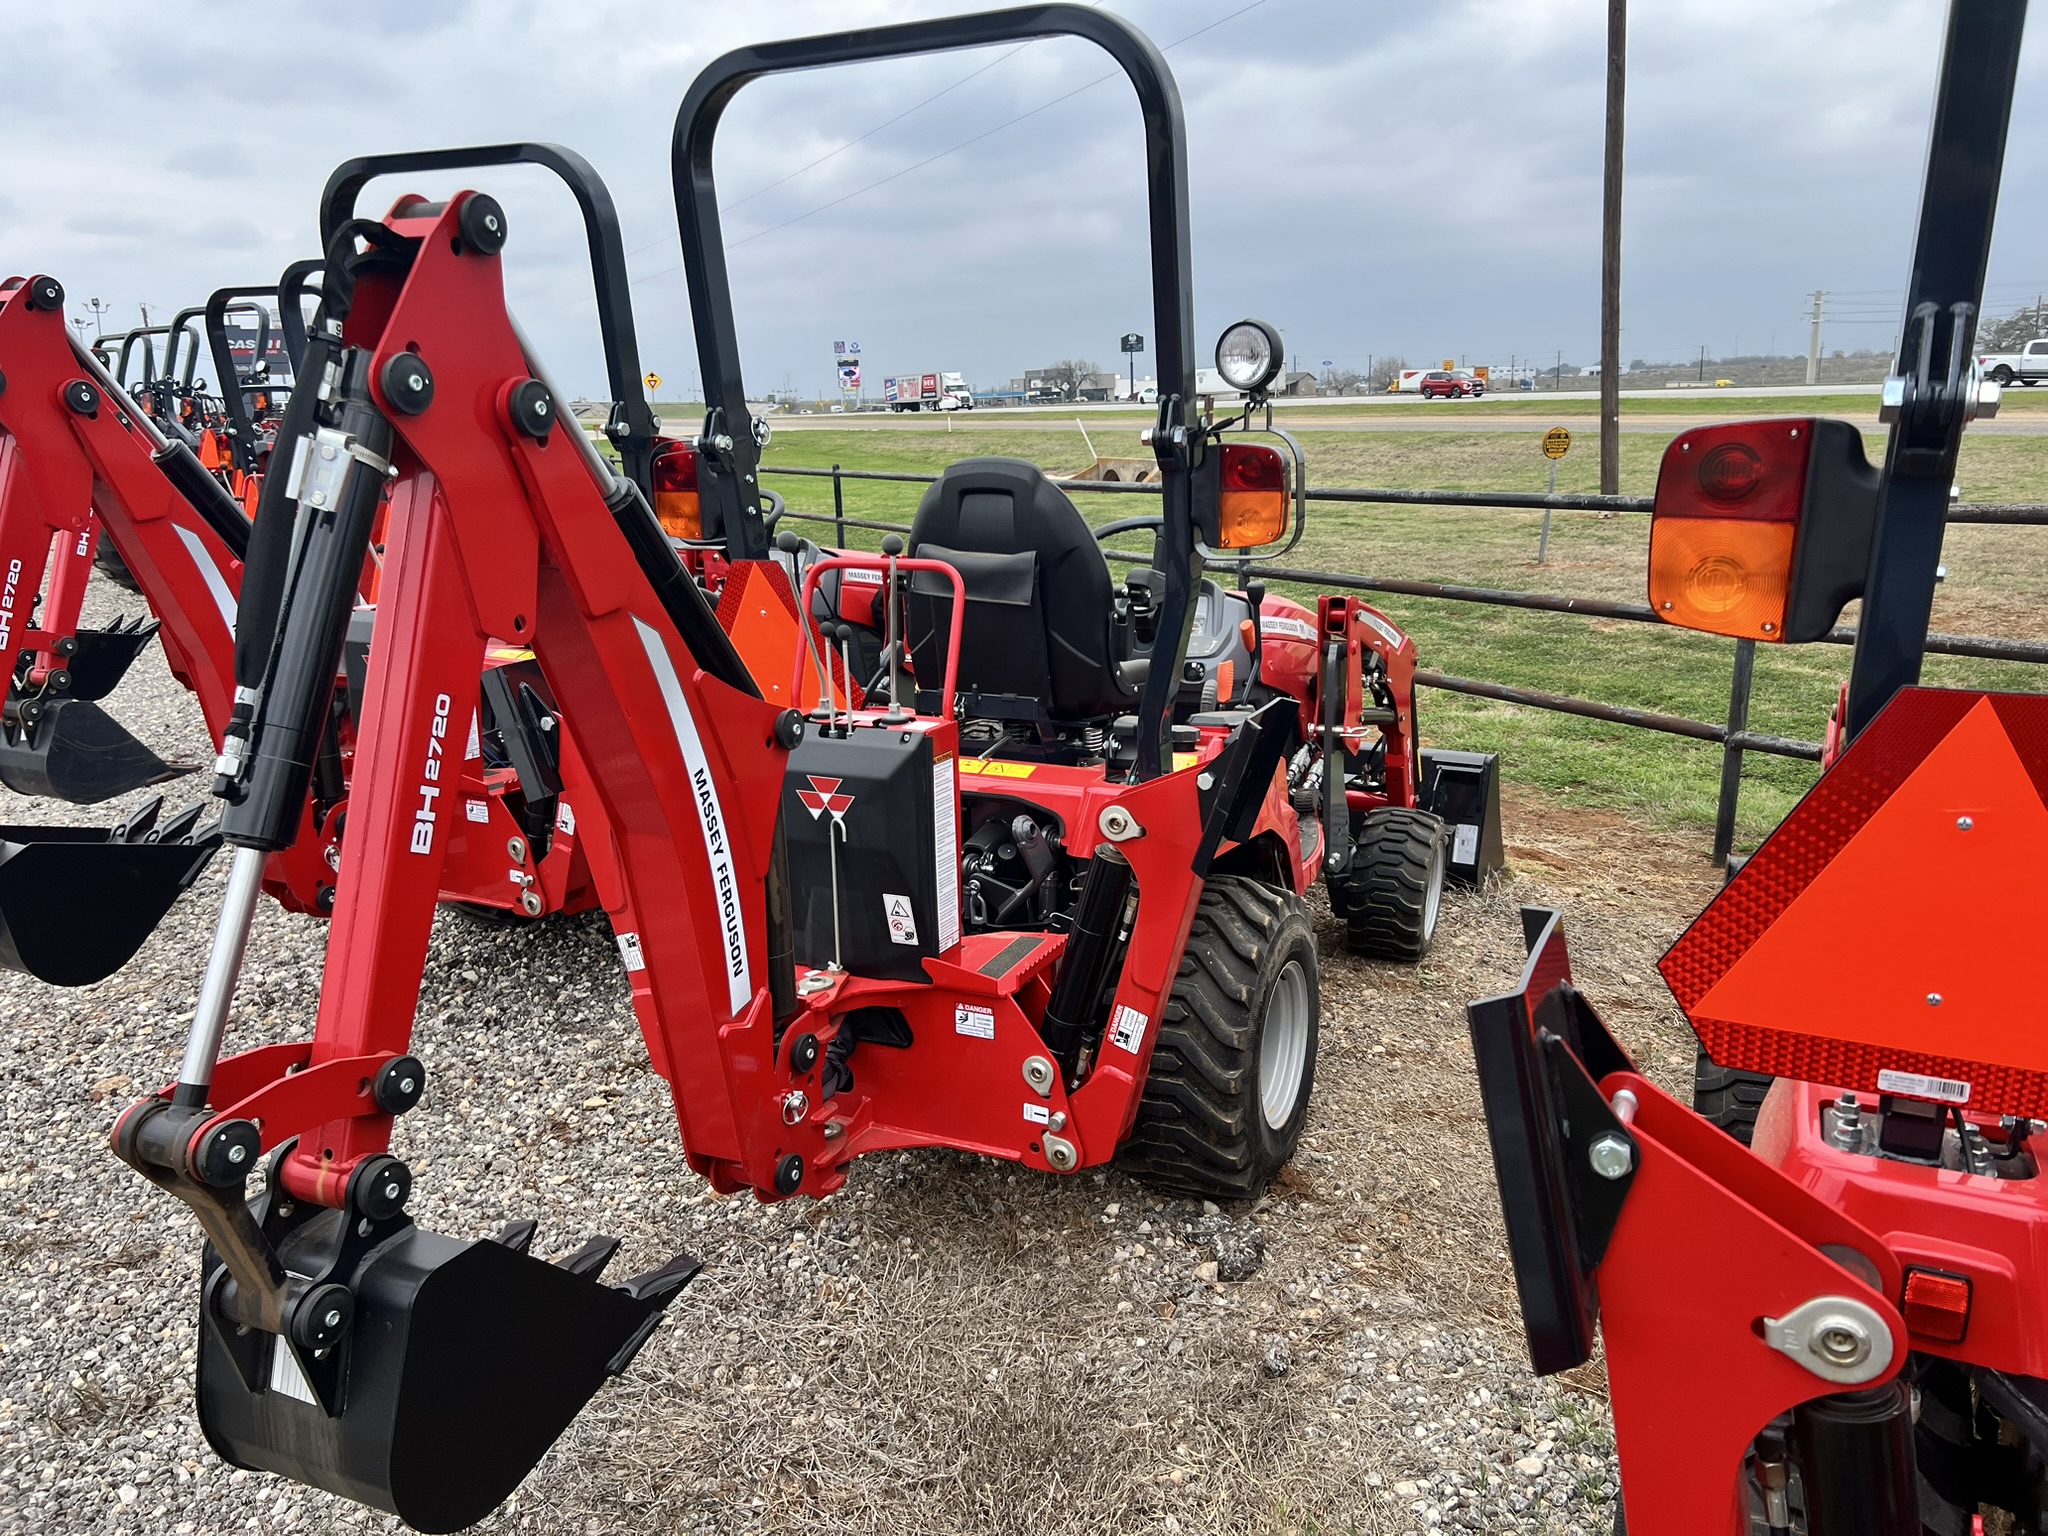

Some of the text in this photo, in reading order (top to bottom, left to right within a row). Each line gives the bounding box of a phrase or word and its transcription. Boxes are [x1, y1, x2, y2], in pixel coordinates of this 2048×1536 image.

[1, 558, 23, 609] 2720
[847, 571, 870, 581] MASSEY
[410, 693, 451, 855] BH 2720
[694, 767, 744, 978] MASSEY FERGUSON
[964, 1004, 993, 1015] DANGER
[1111, 1004, 1125, 1033] DANGER
